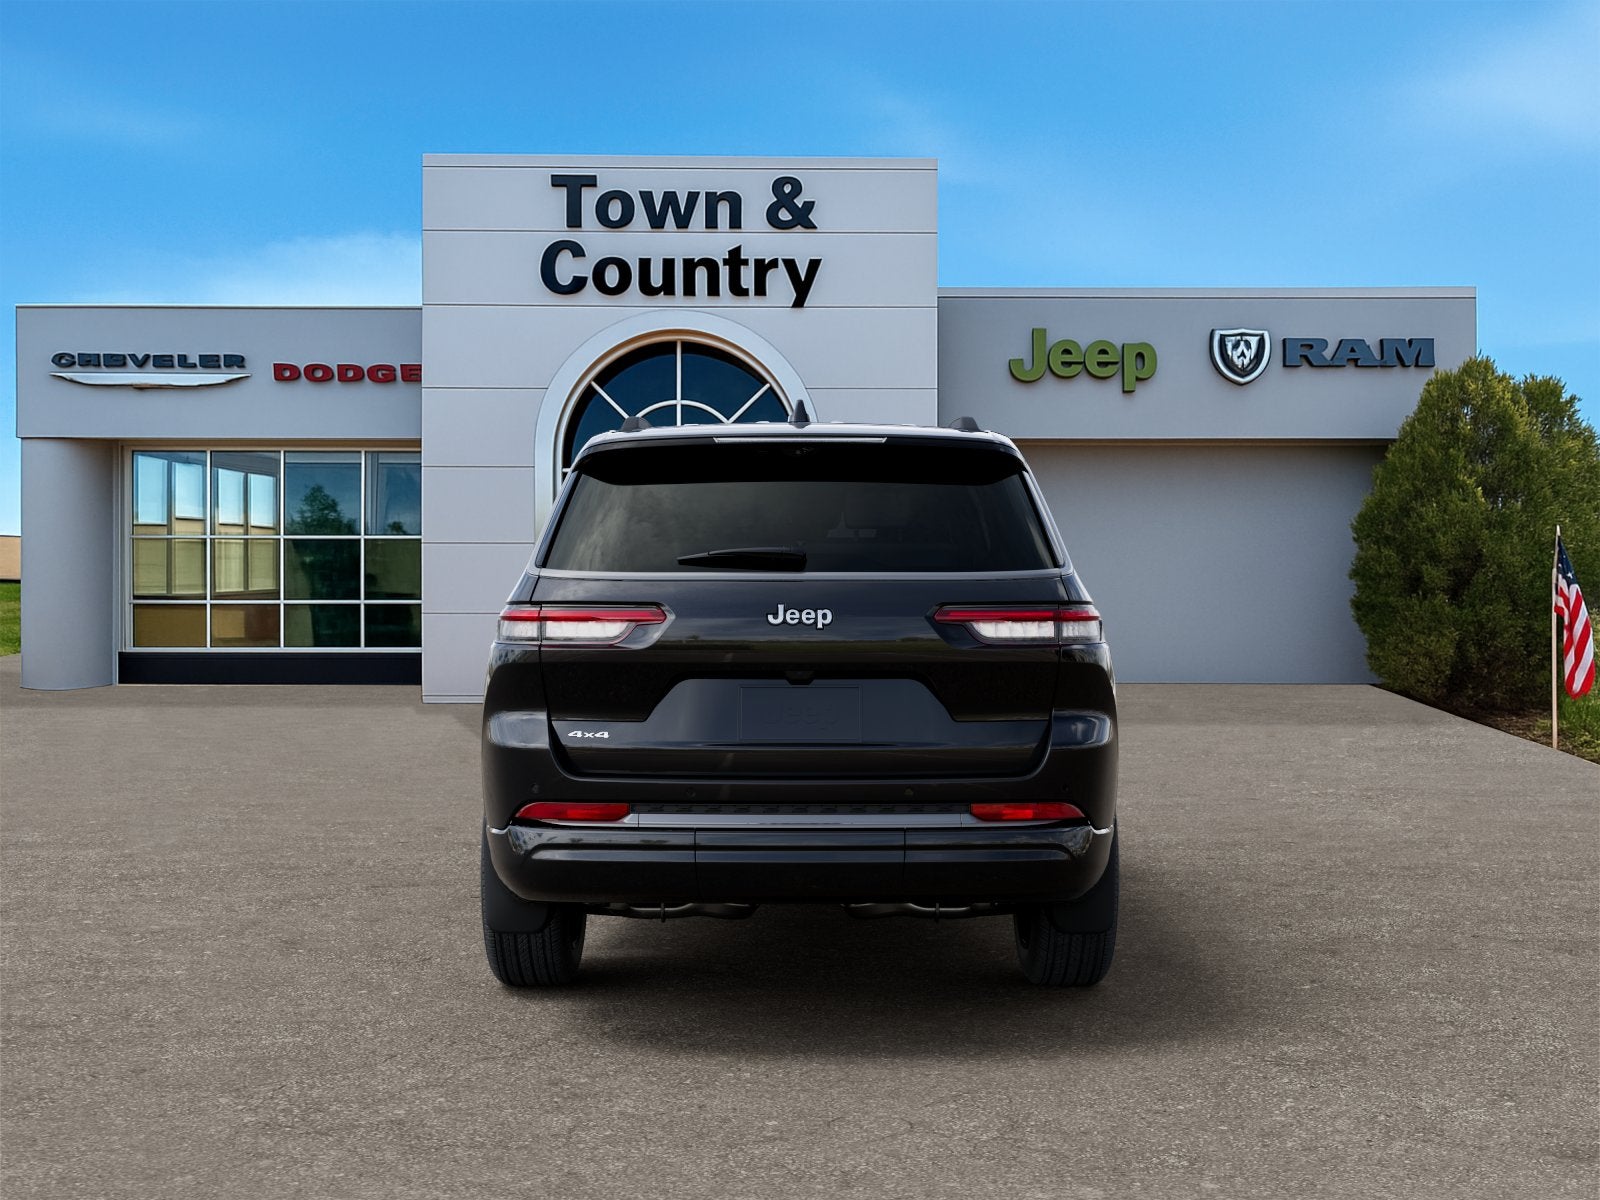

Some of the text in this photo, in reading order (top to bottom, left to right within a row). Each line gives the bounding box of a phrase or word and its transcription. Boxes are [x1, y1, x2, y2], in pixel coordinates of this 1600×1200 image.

[550, 174, 818, 230] Town &
[540, 239, 822, 308] Country
[1009, 328, 1158, 393] Jeep
[1283, 337, 1436, 368] RAM
[272, 362, 422, 383] DODGE
[766, 603, 834, 630] Jeep
[567, 730, 610, 739] 4x4
